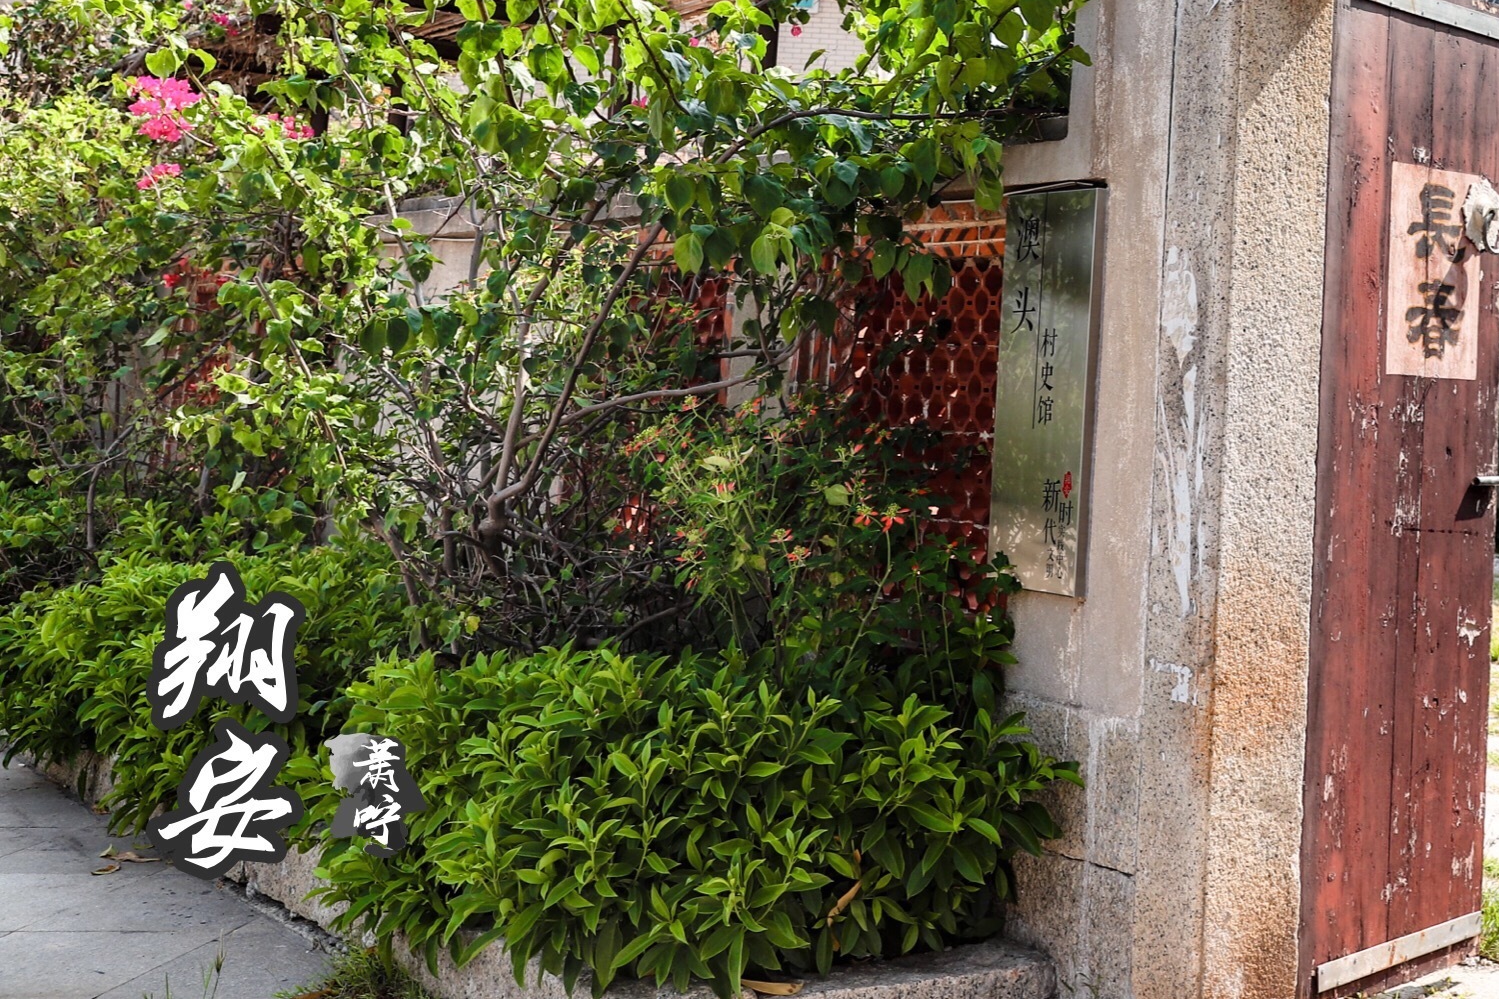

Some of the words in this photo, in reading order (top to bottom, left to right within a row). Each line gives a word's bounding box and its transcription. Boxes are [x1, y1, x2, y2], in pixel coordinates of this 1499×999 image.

[1011, 215, 1040, 333] 澳头
[1036, 328, 1058, 426] 村史馆
